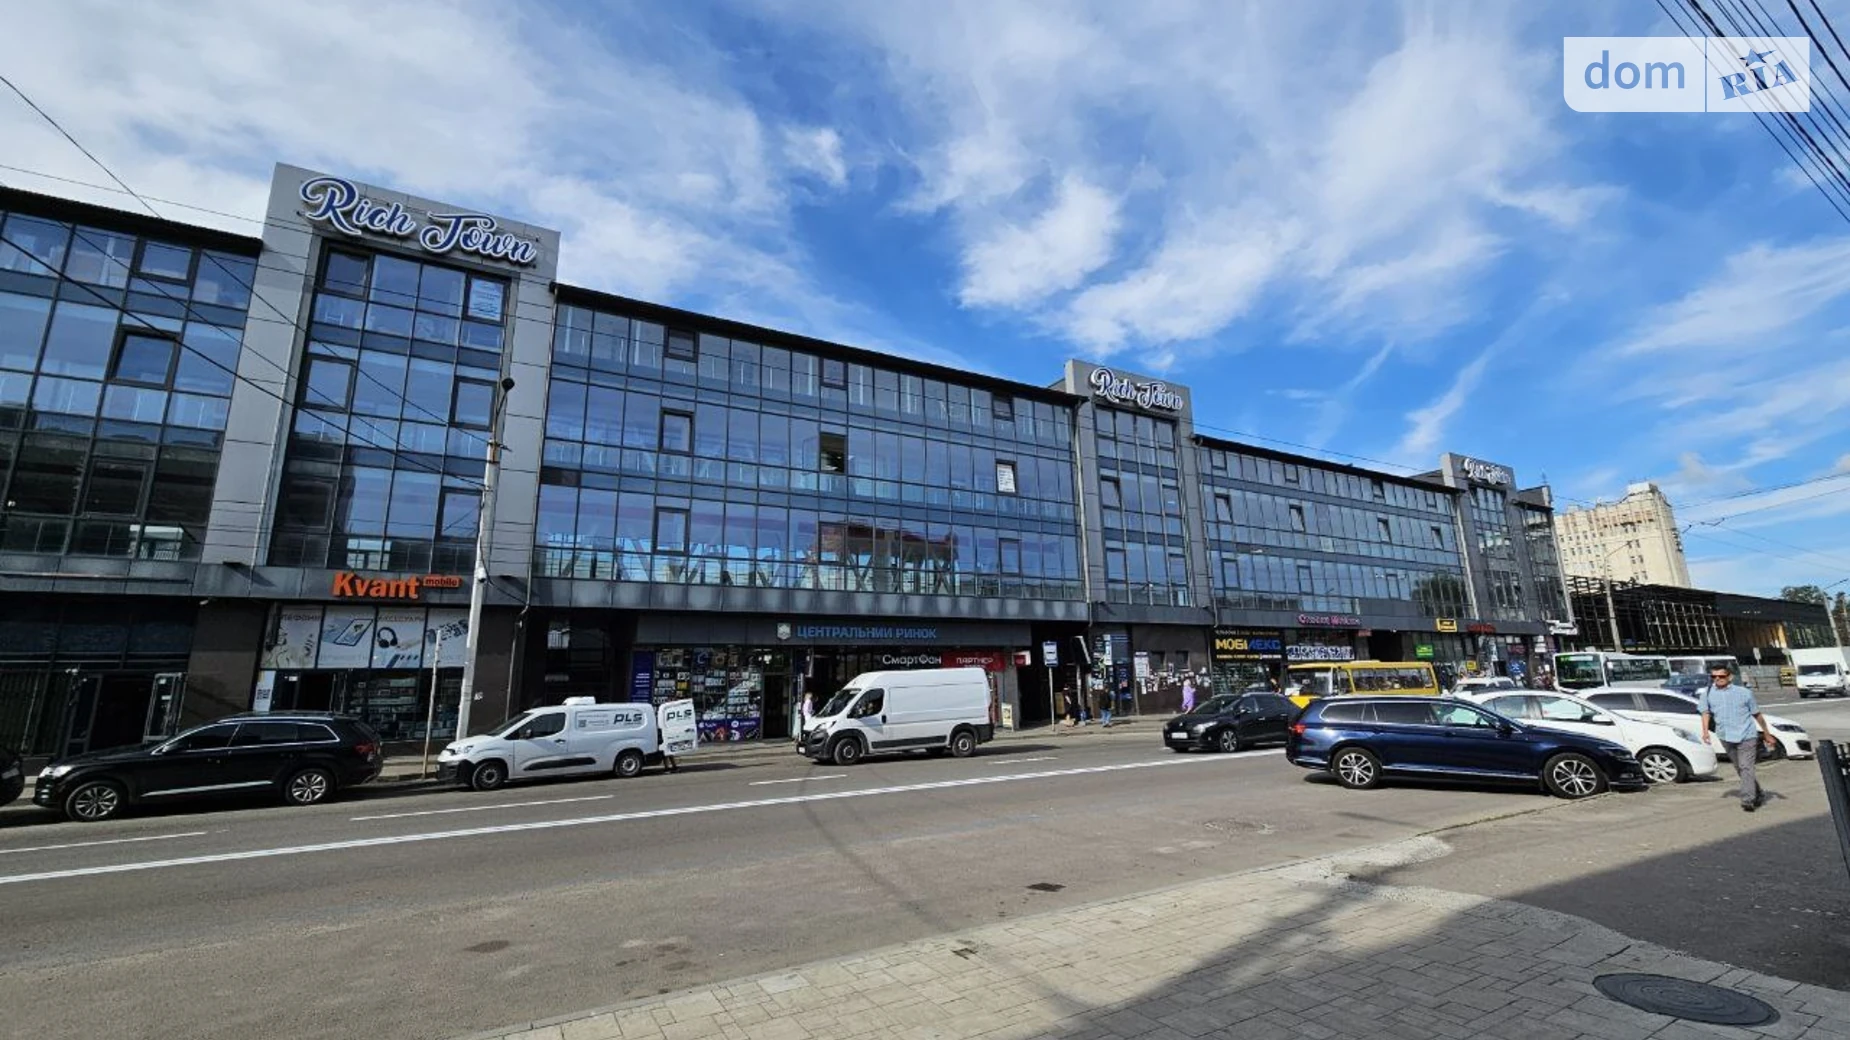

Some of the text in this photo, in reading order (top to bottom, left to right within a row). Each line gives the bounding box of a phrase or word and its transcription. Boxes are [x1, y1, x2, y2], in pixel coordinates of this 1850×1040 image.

[300, 176, 537, 263] Rich Town
[1090, 367, 1184, 409] Rich Town
[332, 572, 419, 599] Kvant
[425, 577, 458, 587] mobile
[896, 628, 936, 639] РИНОК
[614, 713, 642, 725] PLS
[666, 709, 692, 721] PLS
